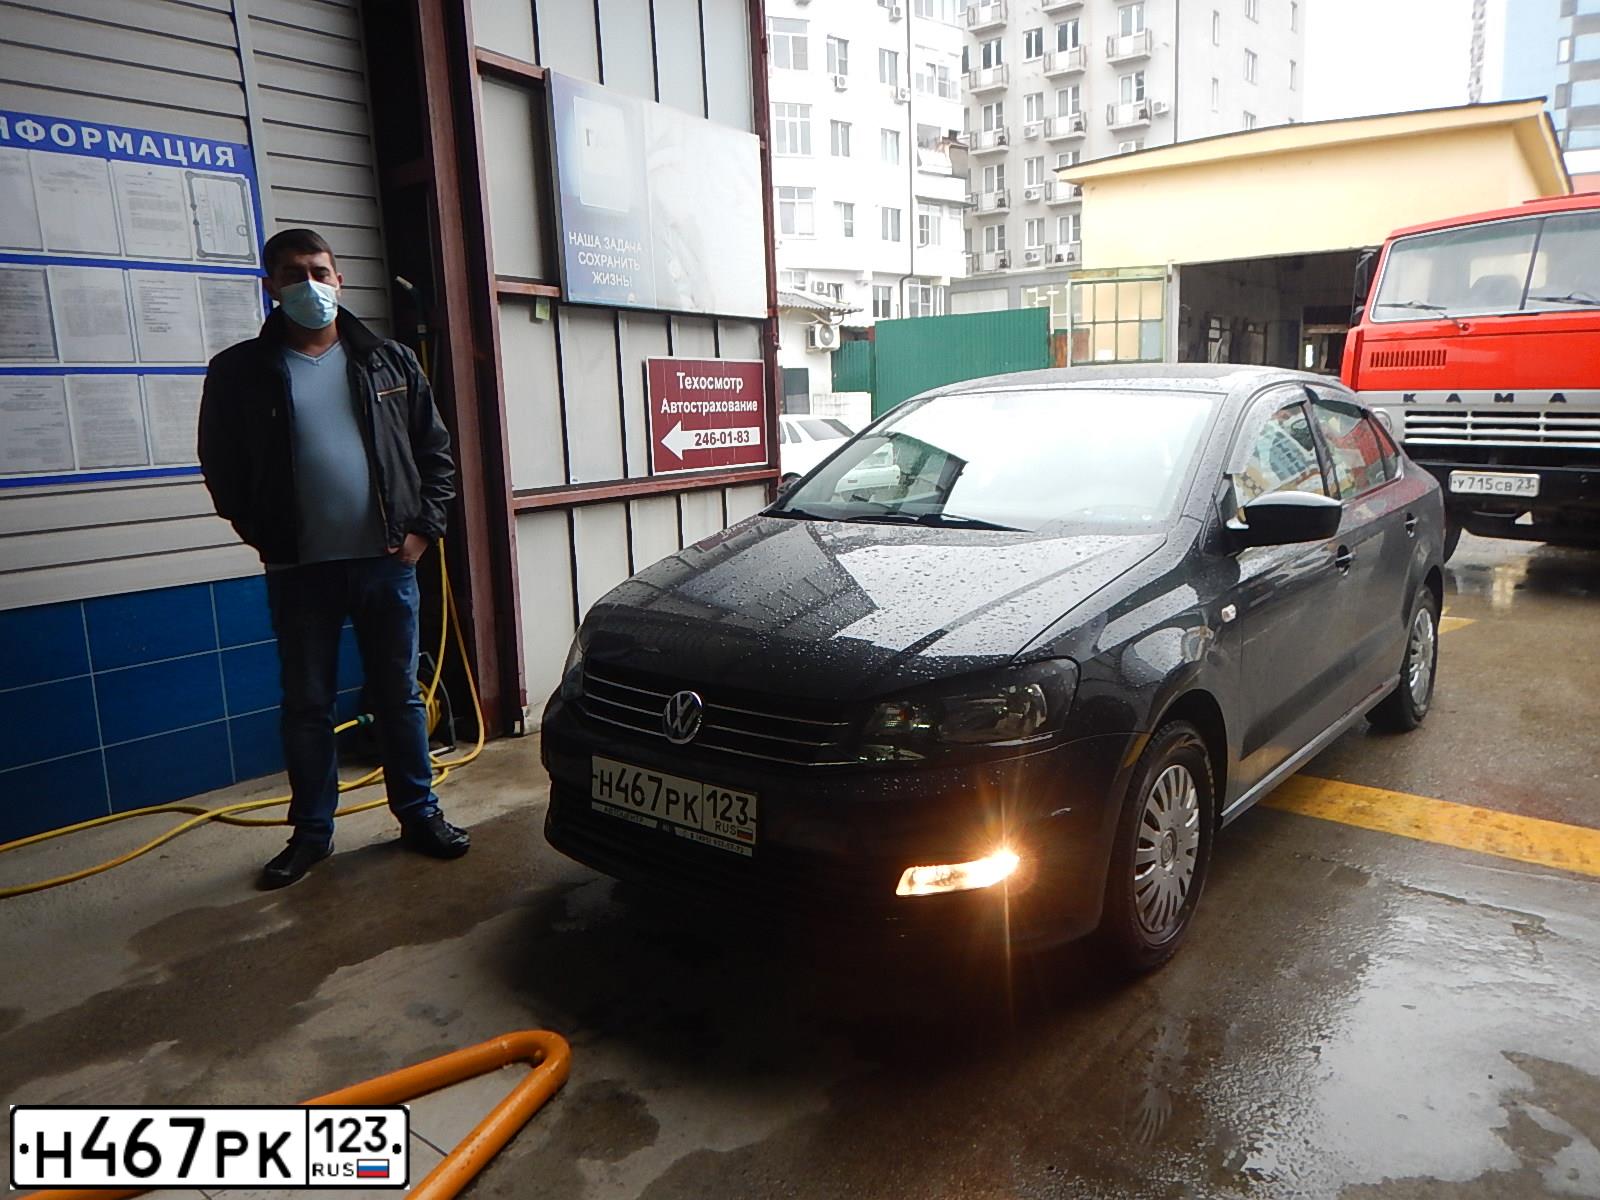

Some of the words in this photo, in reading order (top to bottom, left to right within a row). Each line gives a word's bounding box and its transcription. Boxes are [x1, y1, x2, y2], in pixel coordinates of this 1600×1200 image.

[568, 231, 601, 249] НАША
[604, 236, 642, 253] ЗАДАЧА
[577, 251, 641, 271] СОХРАНИТЬ
[676, 372, 744, 393] Техосмотр
[660, 398, 758, 416] Автострахование
[694, 430, 750, 446] 246-01-83
[706, 789, 749, 826] 123
[714, 821, 738, 836] RUS
